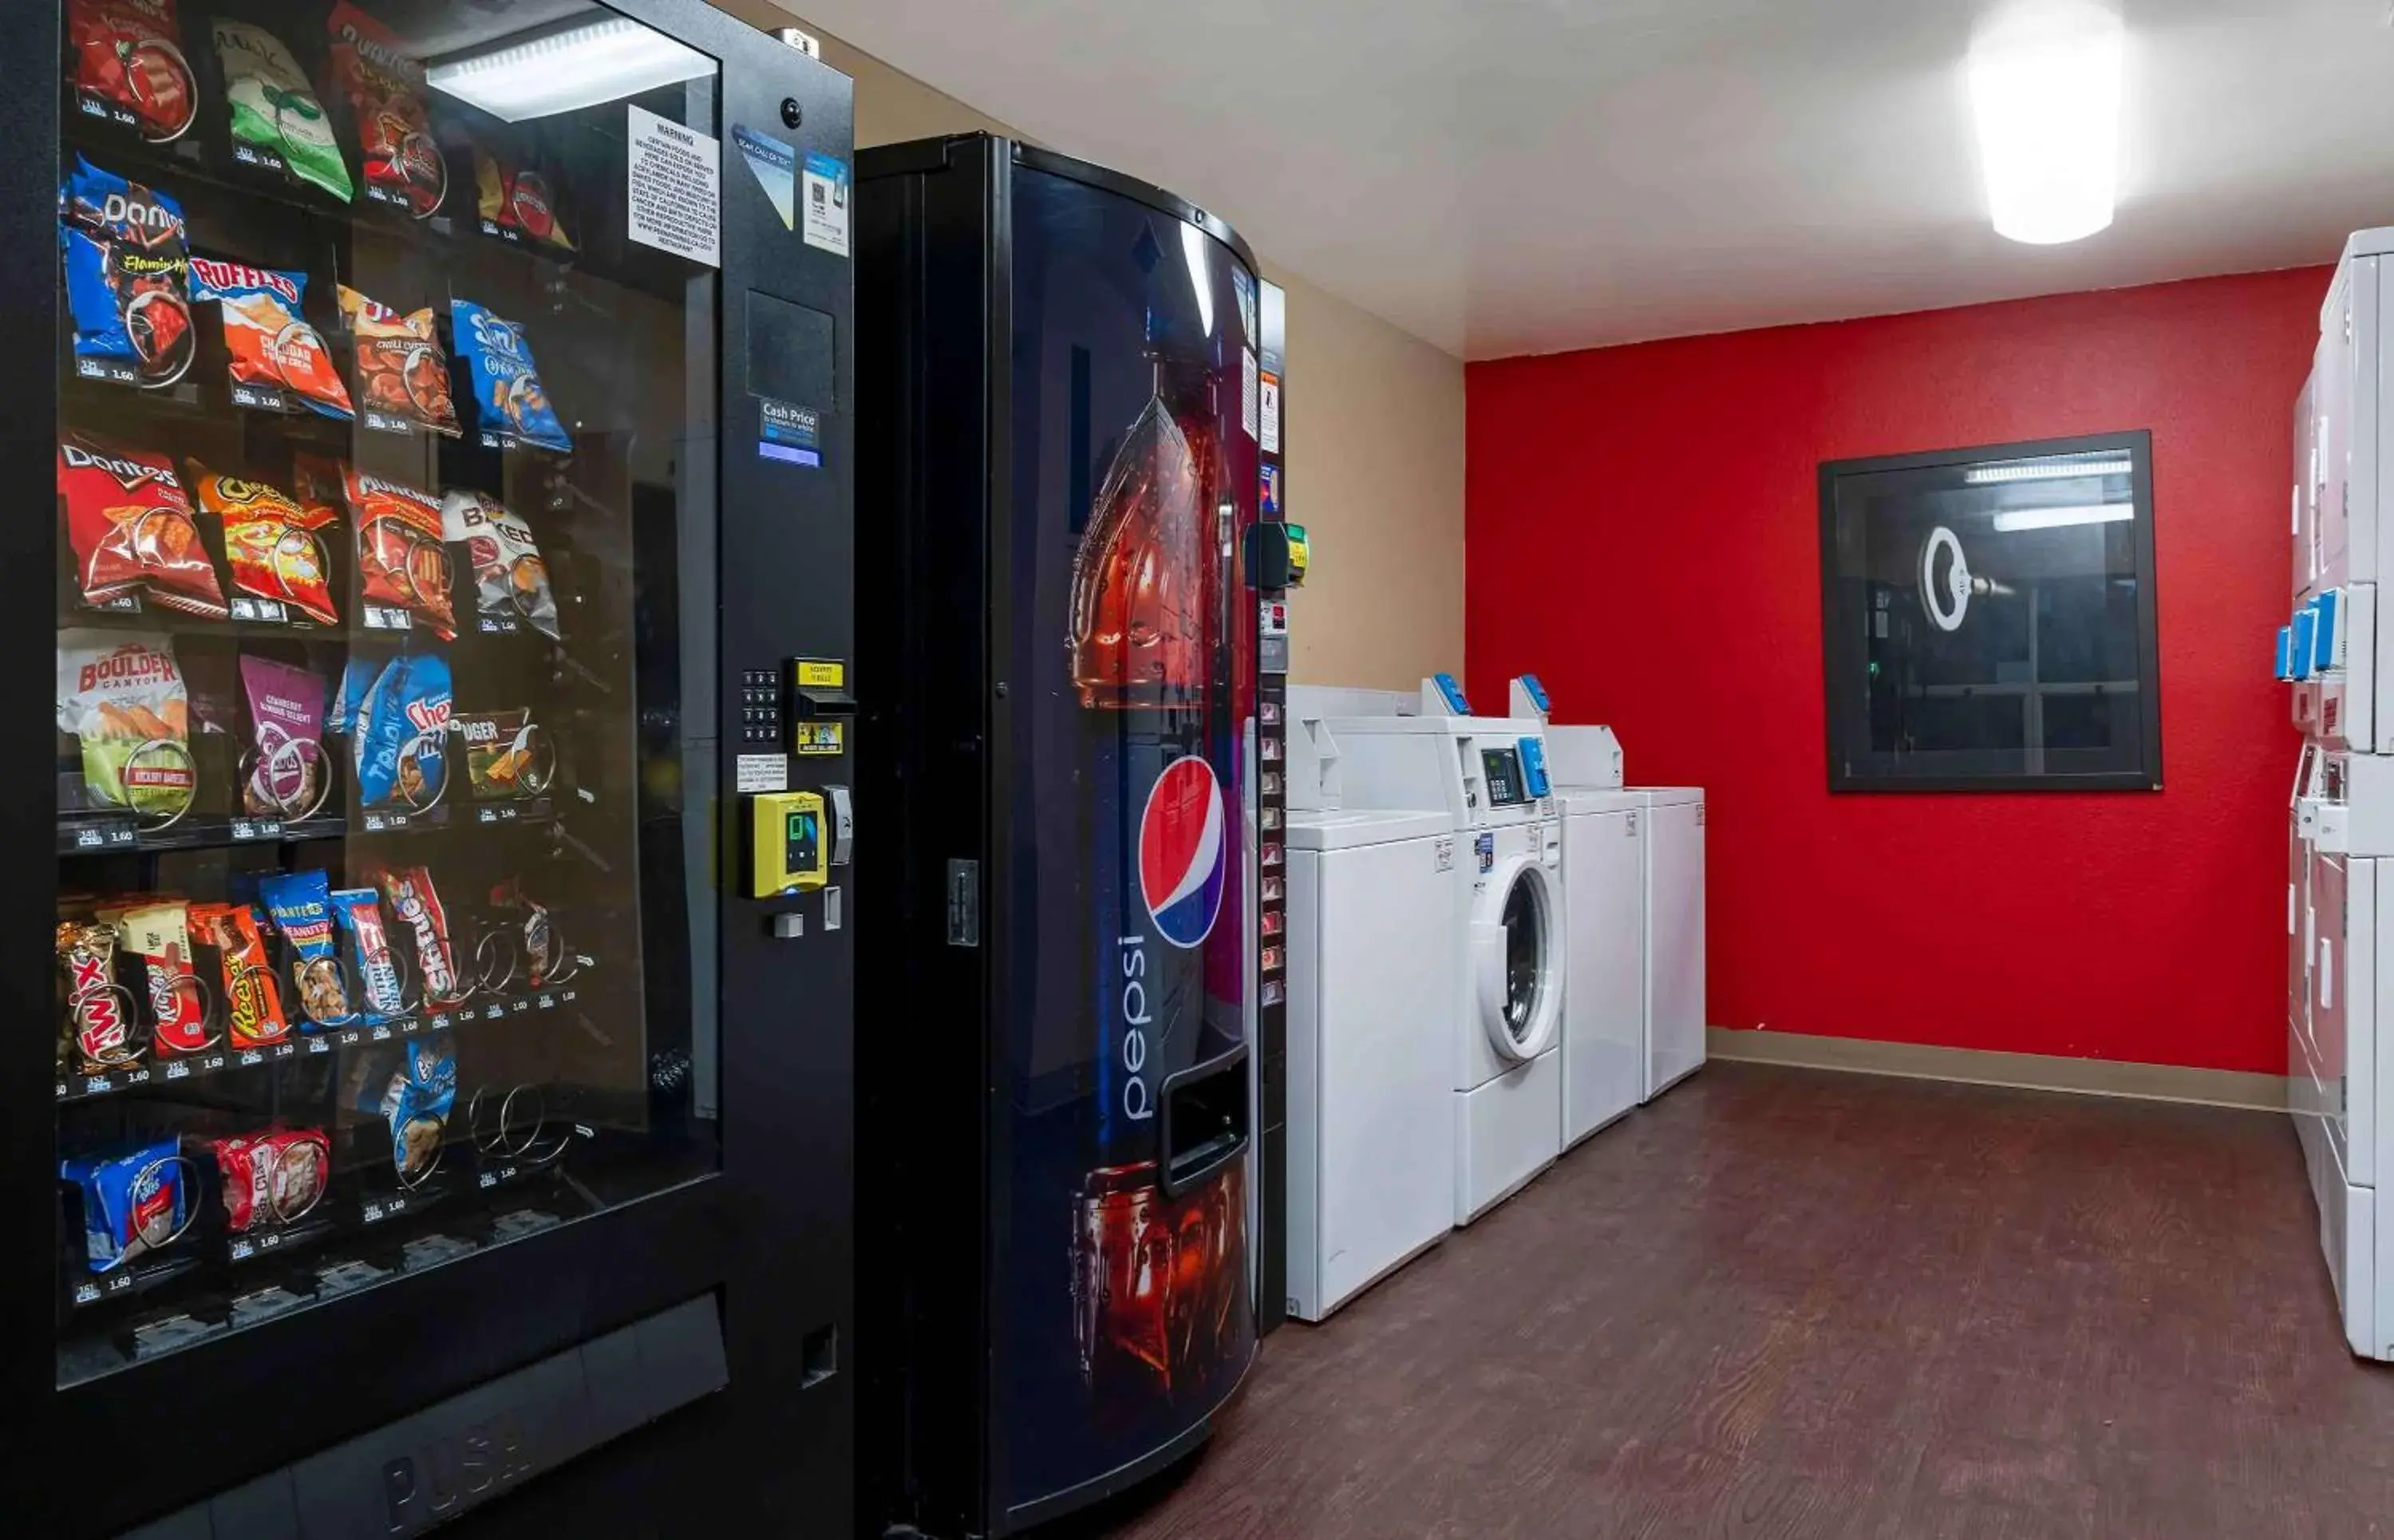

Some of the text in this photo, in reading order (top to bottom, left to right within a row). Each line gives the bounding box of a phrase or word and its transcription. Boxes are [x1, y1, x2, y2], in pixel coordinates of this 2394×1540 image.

[114, 111, 135, 124] 1.60
[263, 157, 281, 168] 1.60
[393, 195, 408, 206] 1.60
[504, 231, 517, 239] 1.60
[189, 258, 298, 304] RUFFLES
[113, 370, 133, 381] 1.60
[262, 397, 279, 407] 1.60
[763, 403, 788, 419] Cash
[790, 409, 815, 425] Price
[61, 444, 179, 488] Doritos
[79, 652, 177, 693] BOULDER
[406, 698, 452, 732] Che
[261, 823, 279, 833] 1.60
[112, 831, 132, 842] 1.60
[225, 954, 260, 1037] Reese's
[69, 958, 125, 1058] TWIX
[1118, 935, 1153, 1120] pepsi
[342, 1034, 358, 1043] 1.60
[276, 1045, 294, 1056] 1.60
[204, 1058, 223, 1069] 1.60
[128, 1071, 149, 1082] 1.60
[501, 1168, 516, 1178] 1.60
[389, 1201, 404, 1210] 1.60
[260, 1235, 278, 1246] 1.60
[109, 1277, 129, 1289] 1.60
